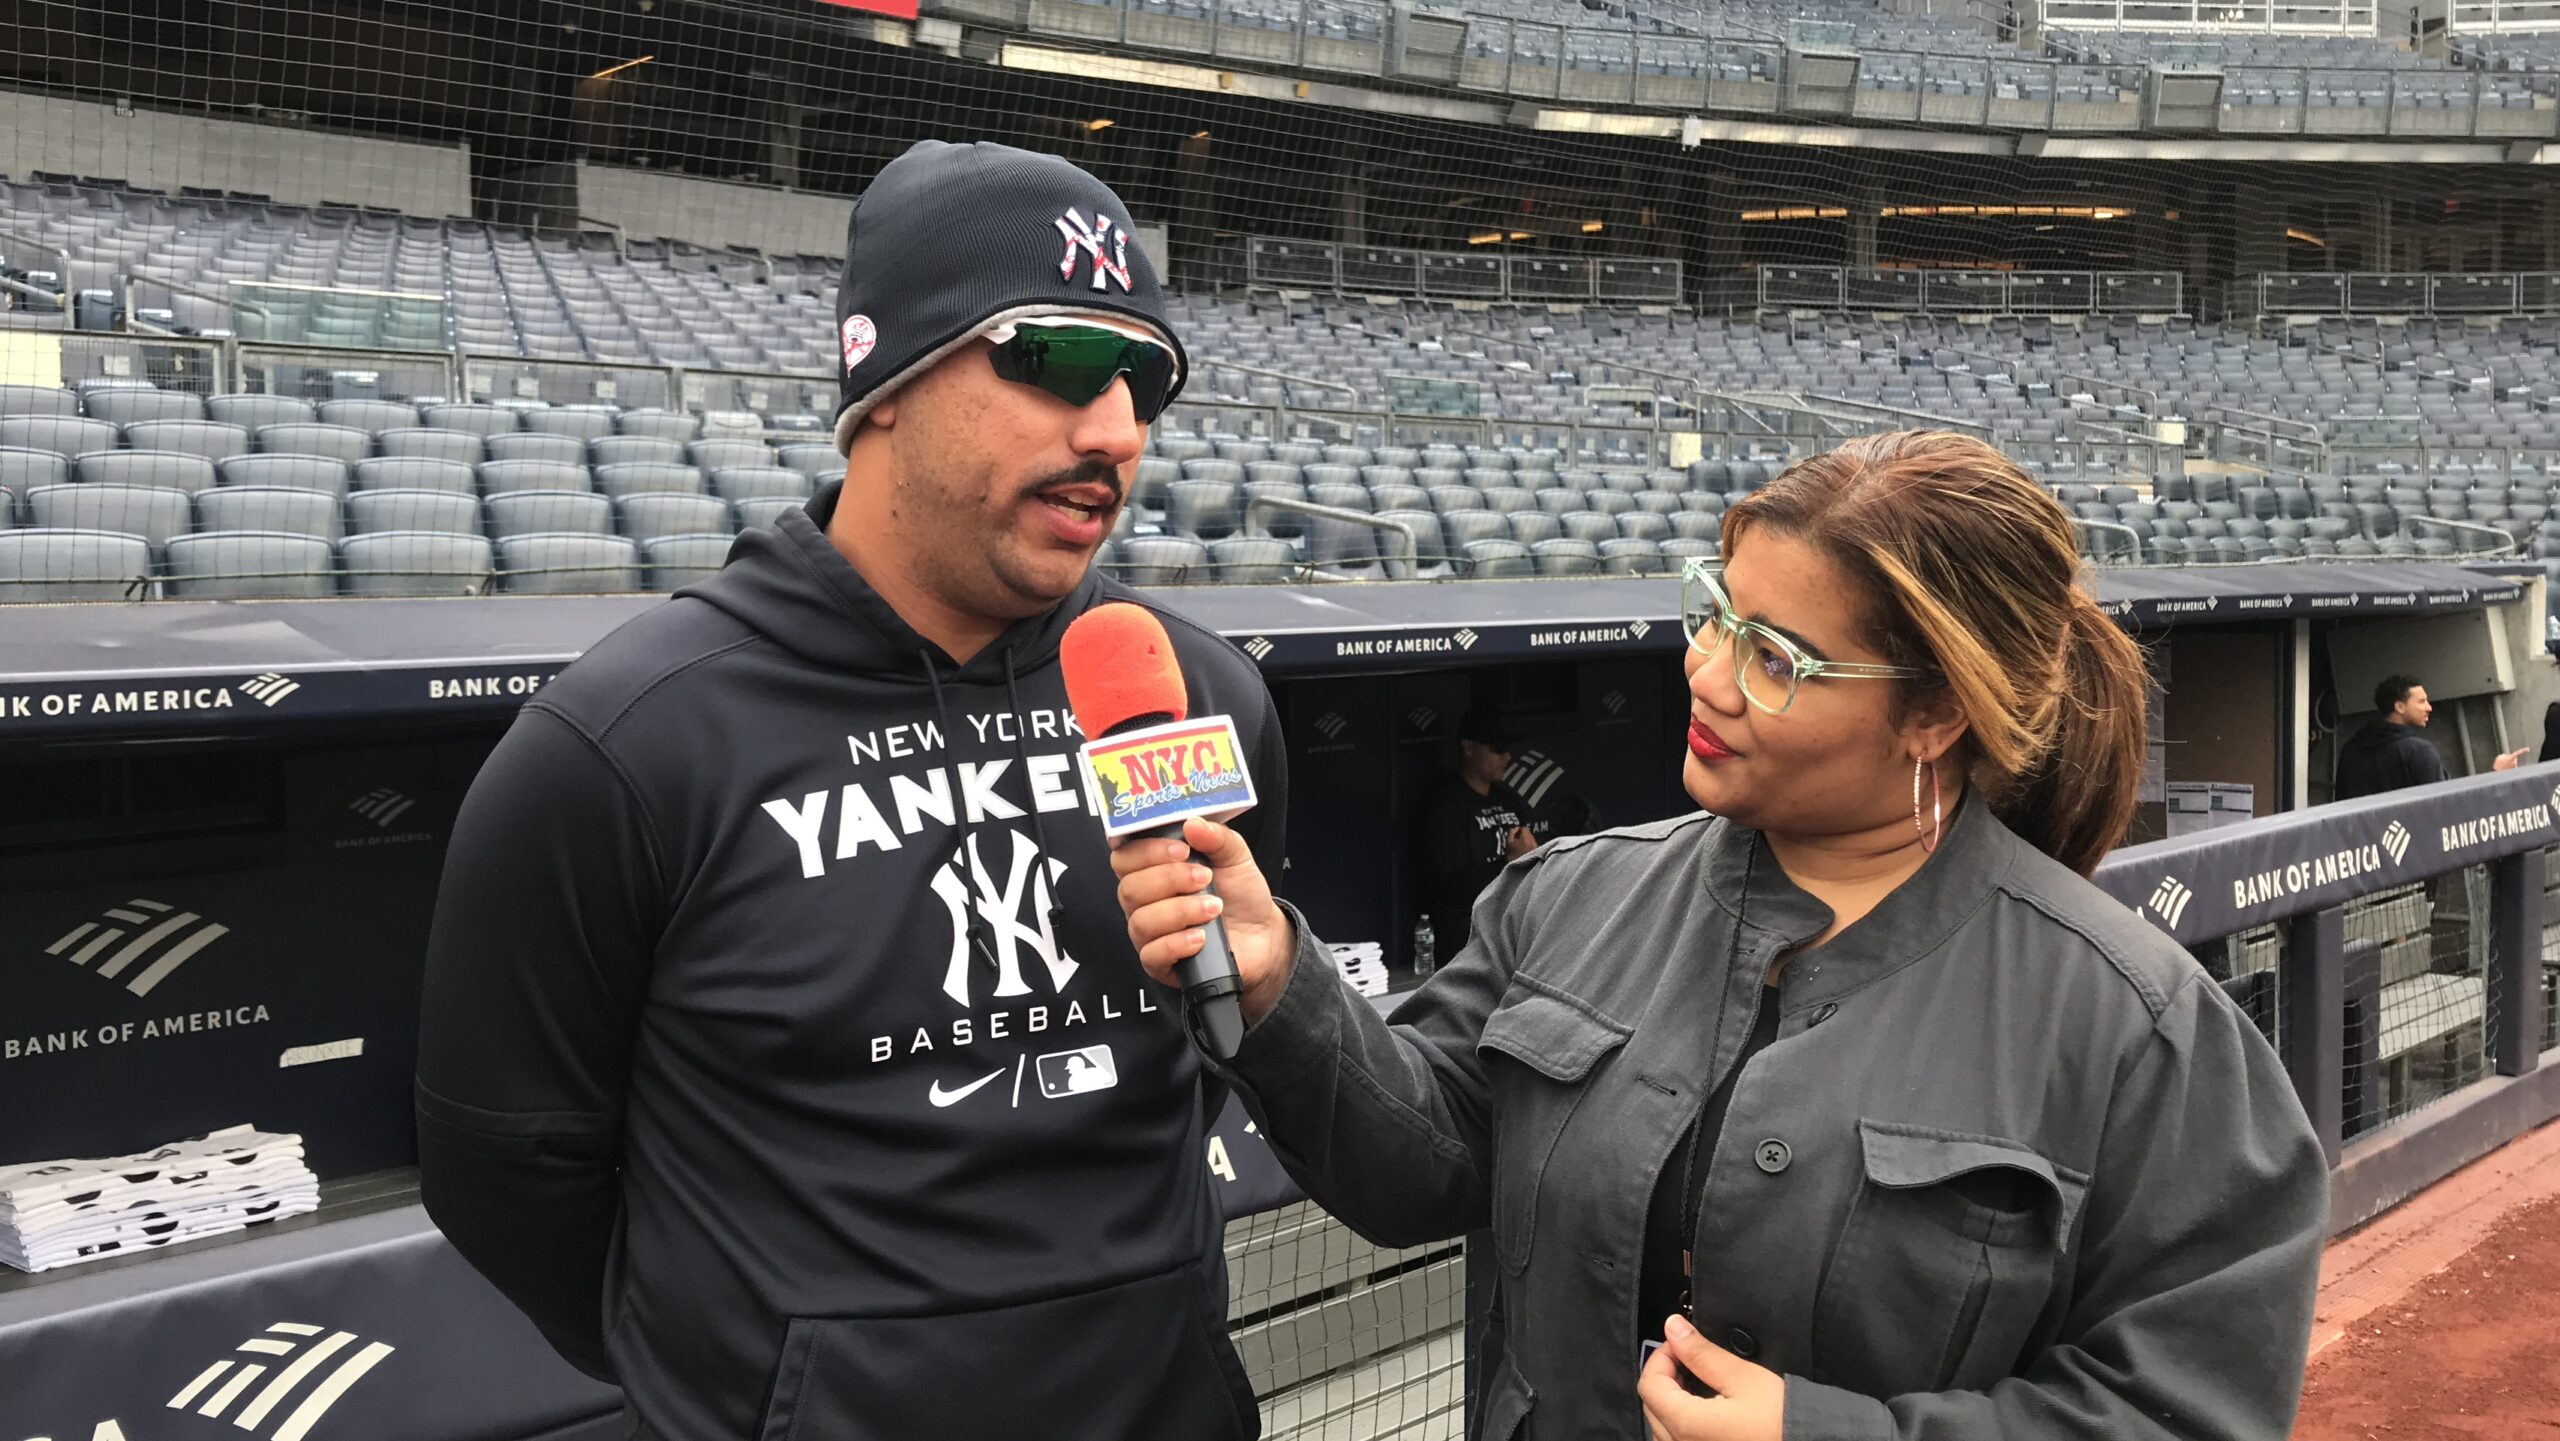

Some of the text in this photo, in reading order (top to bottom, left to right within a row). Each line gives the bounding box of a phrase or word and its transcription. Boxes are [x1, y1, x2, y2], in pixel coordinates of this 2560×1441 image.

[2157, 600, 2207, 613] BANK OF AMERICA
[1337, 637, 1452, 656] BANK OF AMERICA
[1530, 628, 1628, 646] BANK OF AMERICA
[41, 693, 83, 716] OF
[91, 687, 233, 714] AMERICA
[429, 675, 540, 699] BANK OF
[847, 708, 1085, 766] NEW YORK
[1114, 767, 1243, 817] Sports News
[1119, 739, 1222, 797] NYC
[761, 751, 1100, 880] YANKE
[2442, 803, 2551, 852] BANK OF AMERICA
[2234, 844, 2381, 909] BANK OF AMERICA
[930, 829, 1081, 1009] NY
[5, 1004, 270, 1059] BANK OF AMERICA
[871, 988, 1157, 1063] BASEBALL
